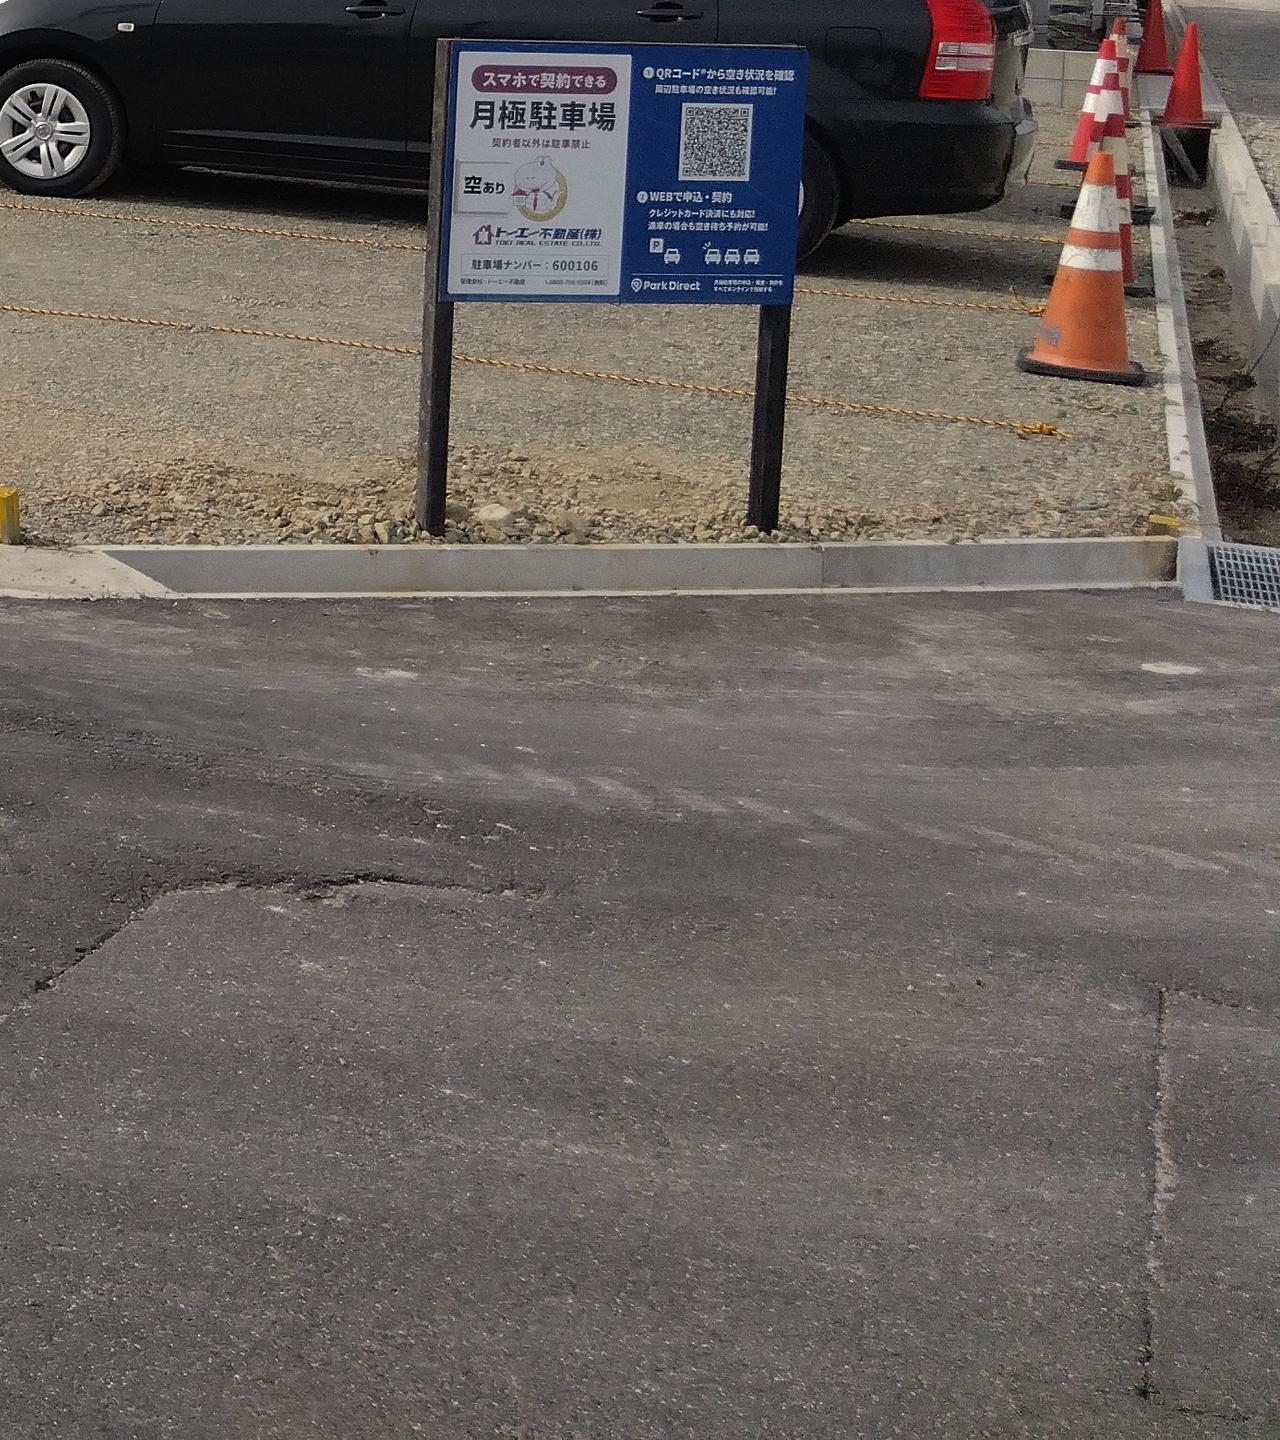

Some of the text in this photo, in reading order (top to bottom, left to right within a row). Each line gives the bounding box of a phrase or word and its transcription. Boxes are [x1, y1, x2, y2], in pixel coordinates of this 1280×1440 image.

[482, 71, 607, 89] スマホで契約できる
[469, 99, 617, 132] 月極駐車場
[492, 137, 591, 149] 契約者以外は駐車禁止
[463, 175, 506, 195] 空あり
[643, 279, 701, 292] Park Direct
